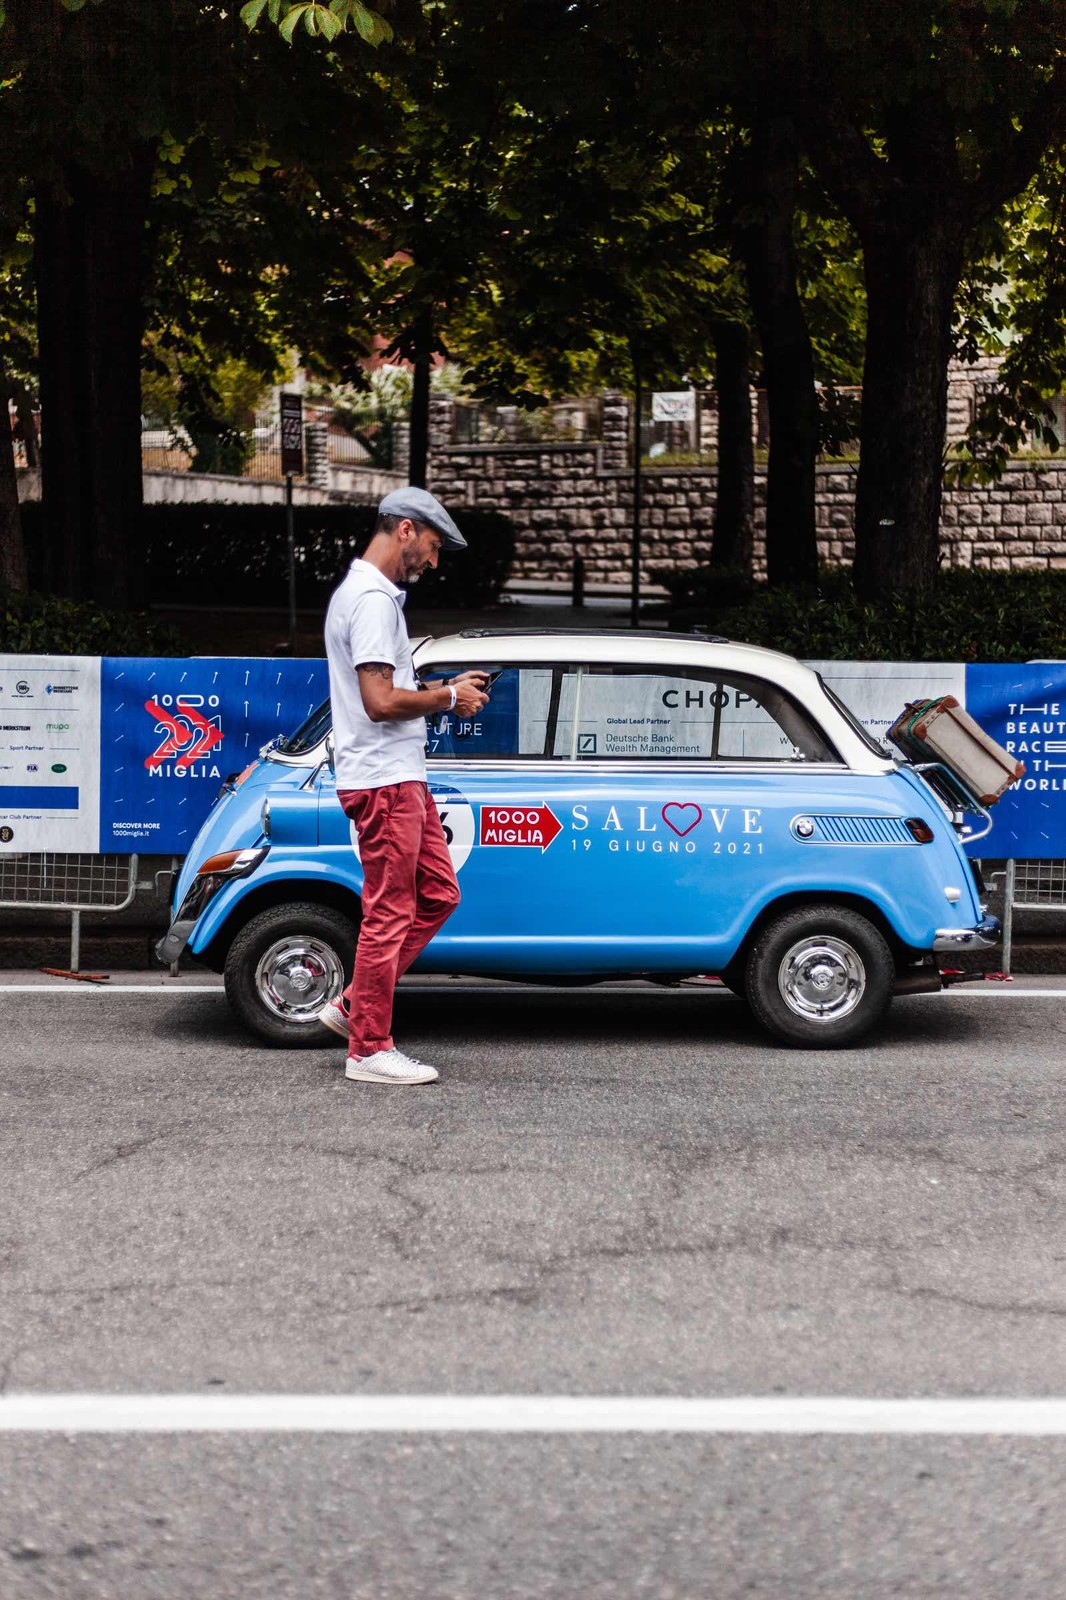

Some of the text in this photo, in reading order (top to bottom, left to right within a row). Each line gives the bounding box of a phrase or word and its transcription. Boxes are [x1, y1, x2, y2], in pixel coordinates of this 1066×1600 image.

[151, 694, 220, 707] 1000
[1008, 703, 1060, 715] THE
[1006, 722, 1066, 734] BEAUT
[153, 714, 222, 759] 2021
[605, 733, 675, 743] Deutsche Bank
[605, 743, 701, 755] Wealth Management
[149, 765, 221, 778] MIGLIA
[488, 810, 540, 825] 1000
[112, 822, 142, 830] DISCOVER
[112, 830, 150, 838] 1000miglia.it
[484, 829, 543, 844] MIGLIA
[571, 839, 764, 855] 19 GIUGNO 2021
